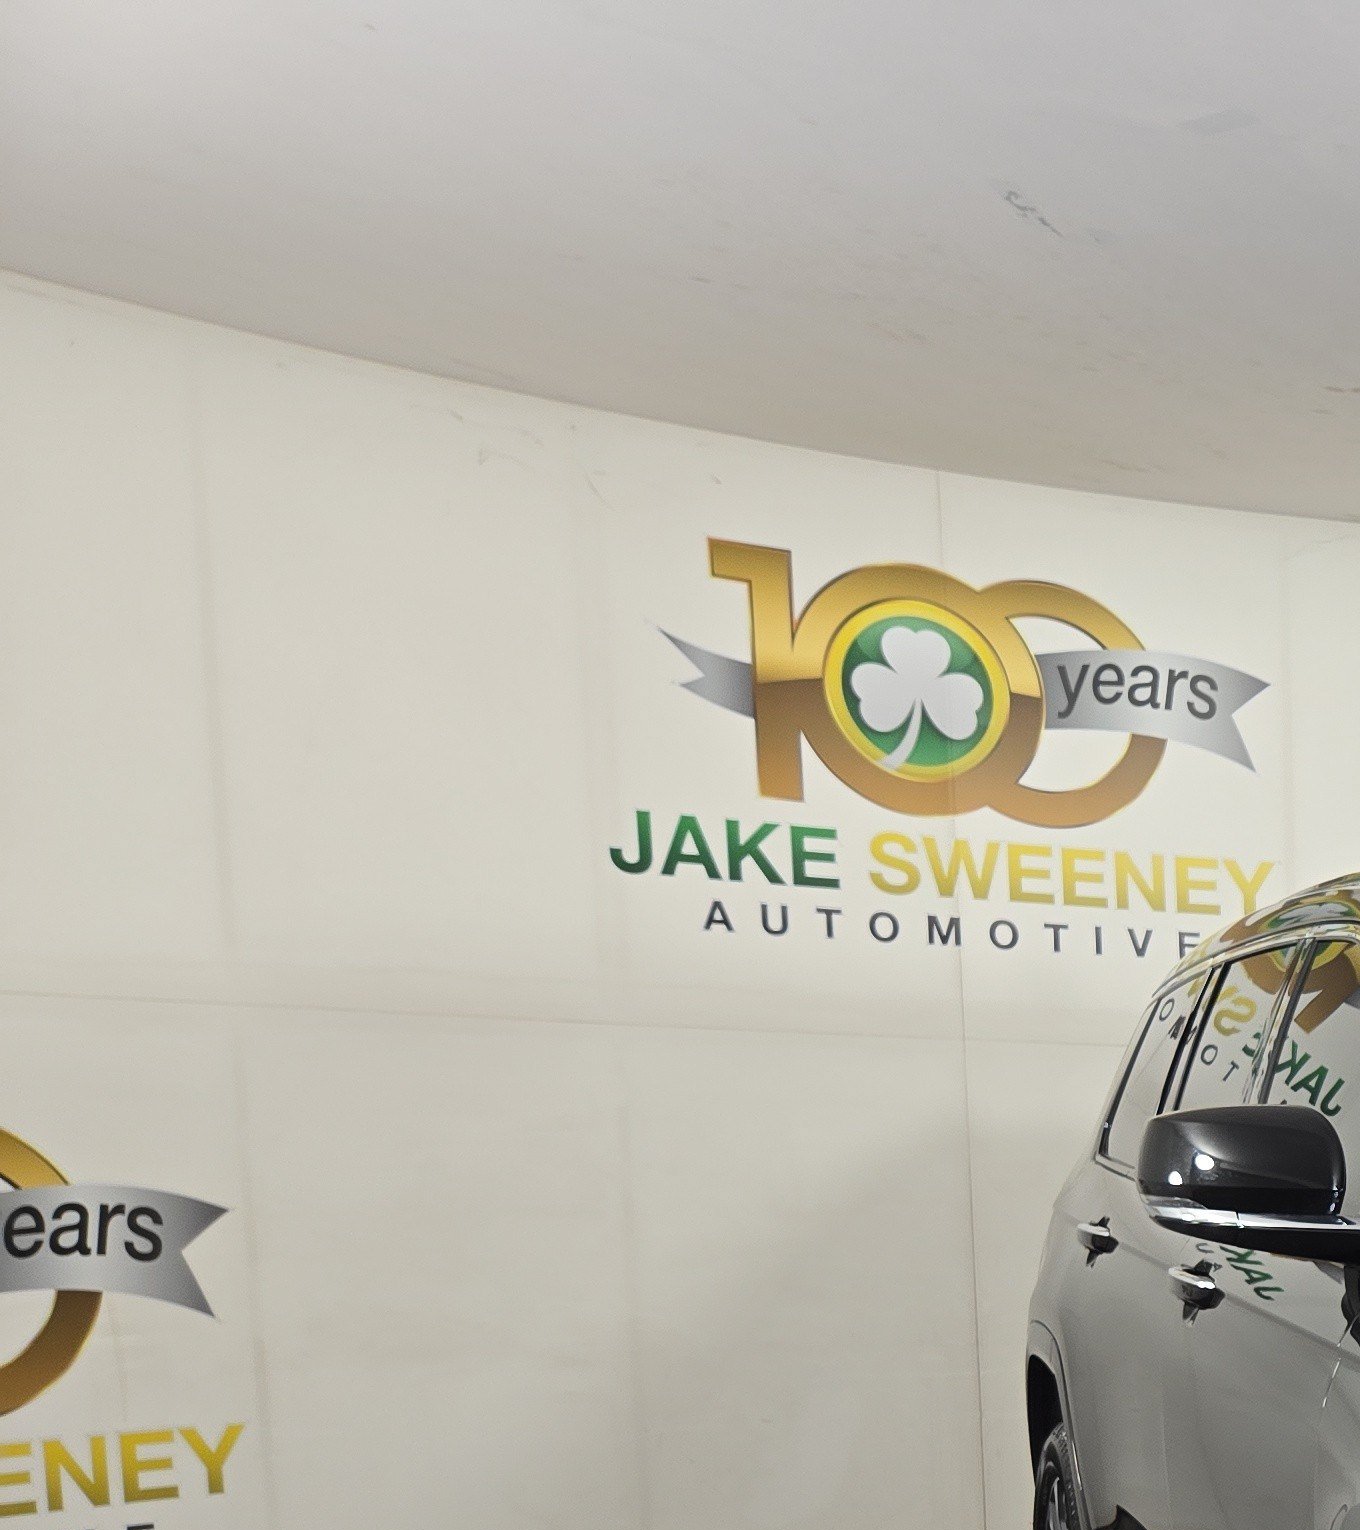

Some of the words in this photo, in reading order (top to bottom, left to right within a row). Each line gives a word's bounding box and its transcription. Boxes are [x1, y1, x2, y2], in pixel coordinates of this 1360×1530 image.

[707, 536, 1168, 829] 100
[1055, 661, 1219, 721] years
[609, 810, 841, 890] JAKE
[868, 830, 1275, 916] SWEENEY
[3, 1201, 164, 1262] ears
